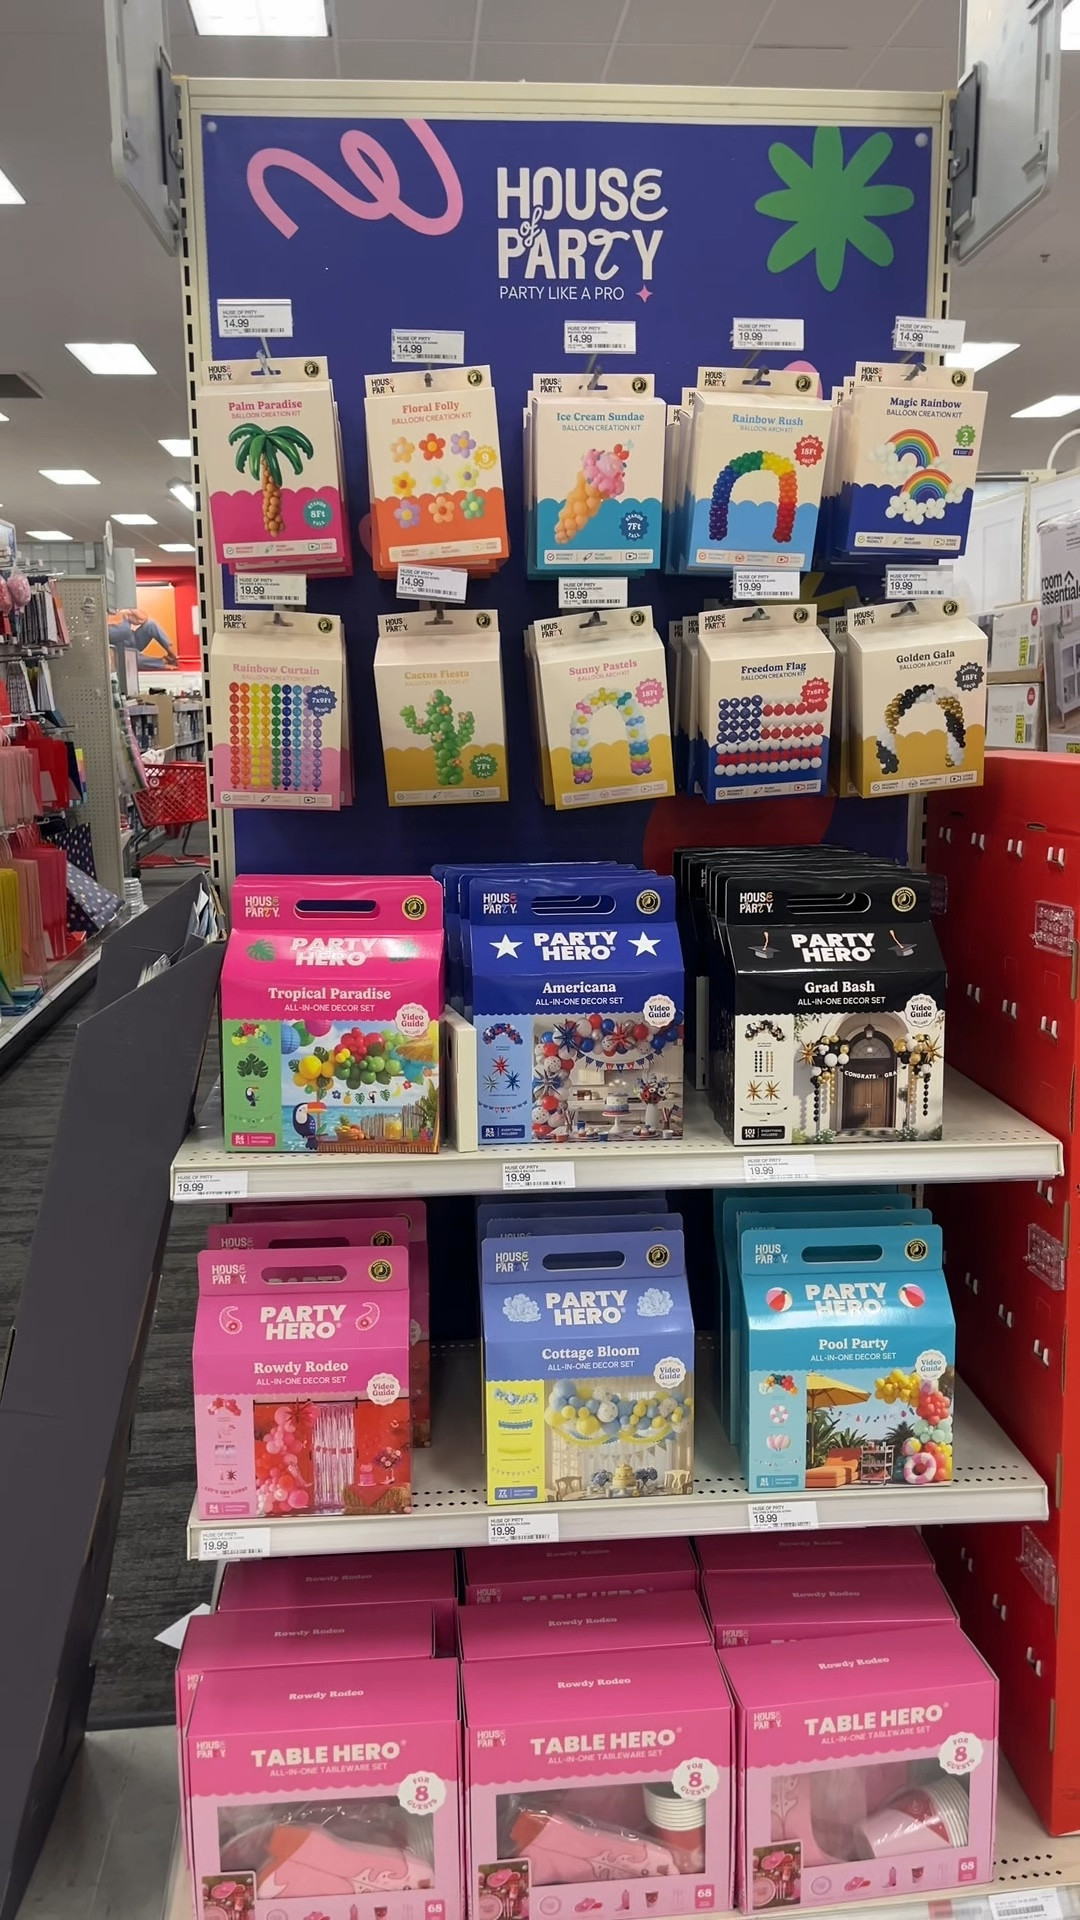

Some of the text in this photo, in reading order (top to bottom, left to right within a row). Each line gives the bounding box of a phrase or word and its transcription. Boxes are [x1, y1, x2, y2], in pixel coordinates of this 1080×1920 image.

[497, 167, 668, 221] HOUSE
[520, 207, 542, 247] of
[498, 228, 663, 280] PARTY
[500, 286, 624, 300] PARTY LIKE A PRO
[224, 319, 249, 328] 14.99
[568, 334, 593, 343] 14.99
[738, 332, 763, 342] 19.99
[899, 332, 924, 342] 14.99
[397, 344, 422, 354] 14.99
[229, 400, 303, 411] Palm Paradise
[403, 401, 460, 414] Floral Folly
[890, 397, 962, 409] Magic Rainbow
[557, 413, 644, 421] Ice Cream Sundae
[886, 409, 917, 417] BALLOON
[918, 410, 951, 418] CREATION
[391, 417, 424, 425] BALLOON
[425, 414, 460, 423] CREATION
[733, 414, 803, 426] Rainbow Rush
[482, 454, 488, 463] 9
[310, 510, 325, 519] 8Ft
[628, 522, 642, 530] 7Ft
[400, 577, 424, 587] 14.99
[738, 583, 761, 591] 19.99
[890, 582, 912, 590] 19.99
[1042, 573, 1062, 591] room
[240, 586, 264, 594] 19.99
[564, 591, 588, 599] 19.99
[896, 650, 955, 663] Golden Gala
[233, 663, 320, 675] Rainbow Curtain
[569, 660, 638, 677] Sunny Pastels
[741, 662, 806, 674] Freedom Flag
[899, 662, 926, 670] BALLOON
[404, 669, 469, 680] Cactus Fiesta
[740, 892, 774, 902] HOUSE
[533, 931, 618, 946] PARTY
[791, 933, 874, 948] PARTY
[292, 938, 380, 951] PARTY
[543, 981, 616, 994] Americana
[805, 980, 875, 993] Grad Bash
[268, 988, 391, 1001] Tropical Paradise
[536, 998, 580, 1006] ALL-IN-ONE
[798, 998, 842, 1006] ALL-IN-ONE
[843, 997, 870, 1005] DECOR
[284, 1004, 375, 1012] ALL-IN-ONE DECOR SET
[401, 1013, 424, 1021] Video
[750, 1166, 774, 1175] 19.99
[506, 1173, 531, 1182] 19.99
[178, 1183, 204, 1192] 19.99
[805, 1282, 887, 1300] PARTY
[545, 1290, 628, 1309] PARTY
[260, 1304, 347, 1323] PARTY
[819, 1338, 888, 1351] Pool Party
[542, 1346, 640, 1361] Cottage Bloom
[810, 1354, 853, 1362] ALL-IN-ONE
[855, 1353, 881, 1361] DECOR
[254, 1361, 349, 1376] Rowdy Rodeo
[548, 1363, 591, 1371] ALL-IN-ONE
[593, 1361, 619, 1369] DECOR
[659, 1372, 681, 1380] Guide
[256, 1378, 301, 1386] ALL-IN-ONE
[372, 1389, 395, 1397] Guide
[754, 1514, 778, 1523] 19.99
[492, 1527, 516, 1536] 19.99
[204, 1541, 228, 1550] 19.99
[818, 1657, 890, 1670] Rowdy Rodeo
[557, 1677, 632, 1689] Rowdy Rodeo
[289, 1689, 365, 1700] Rowdy Rodeo
[804, 1712, 877, 1736] TABLE
[821, 1726, 931, 1745] ALL-IN-ONE TABLEWARE SET
[953, 1737, 969, 1745] FOR
[530, 1735, 606, 1756] TABLE
[251, 1745, 329, 1768] TABLE
[548, 1749, 663, 1765] ALL-IN-ONE TABLEWARE SET
[954, 1746, 968, 1762] 8
[270, 1762, 388, 1777] ALL-IN-ONE TABLEWARE SET
[687, 1762, 704, 1771] FOR
[946, 1759, 976, 1770] GUESTS
[412, 1776, 430, 1785] FOR
[689, 1771, 703, 1787] 8
[414, 1786, 429, 1802] 8
[680, 1784, 711, 1796] GUESTS
[406, 1798, 438, 1810] GUESTS
[961, 1861, 975, 1870] 68
[697, 1889, 712, 1897] 68
[428, 1904, 443, 1913] 68
